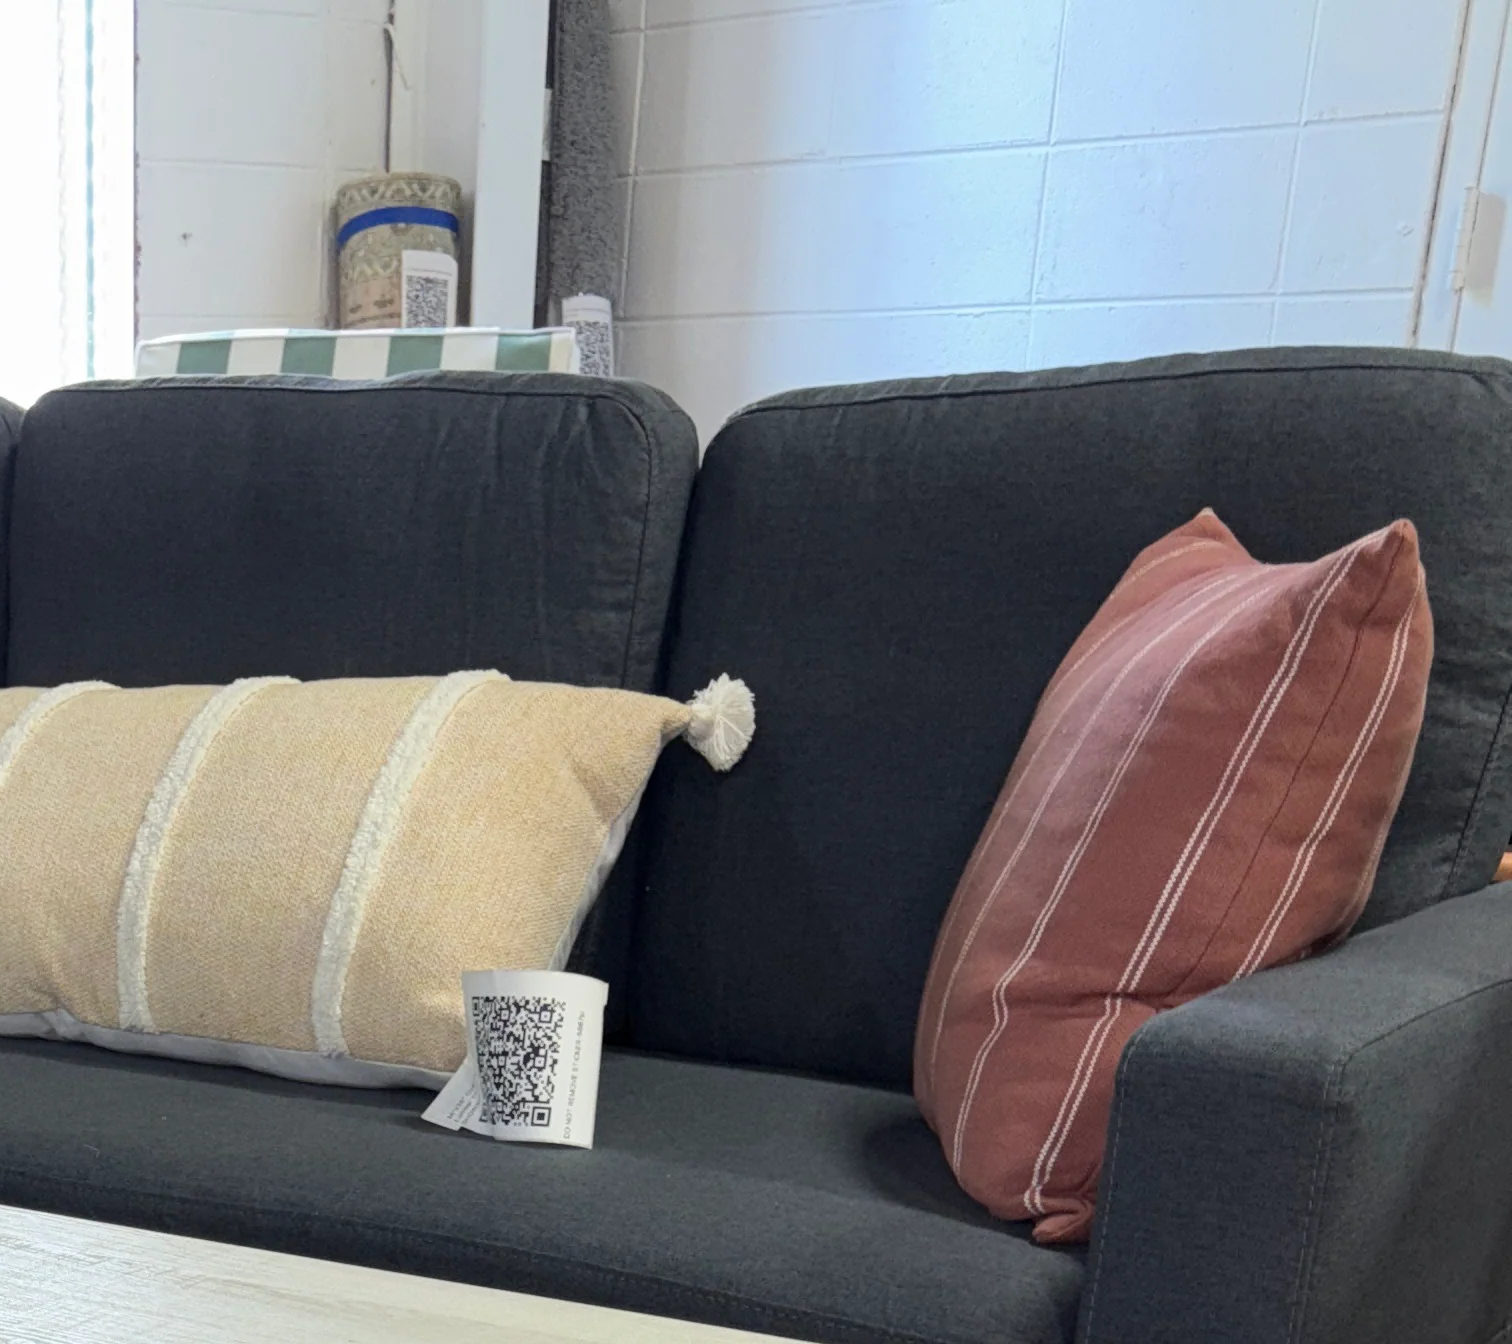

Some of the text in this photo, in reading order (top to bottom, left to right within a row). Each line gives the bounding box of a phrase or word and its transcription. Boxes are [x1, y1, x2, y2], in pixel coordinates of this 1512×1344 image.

[568, 1074, 577, 1106] REMOVE
[565, 1108, 573, 1125] NOT
[563, 1126, 571, 1139] DO
